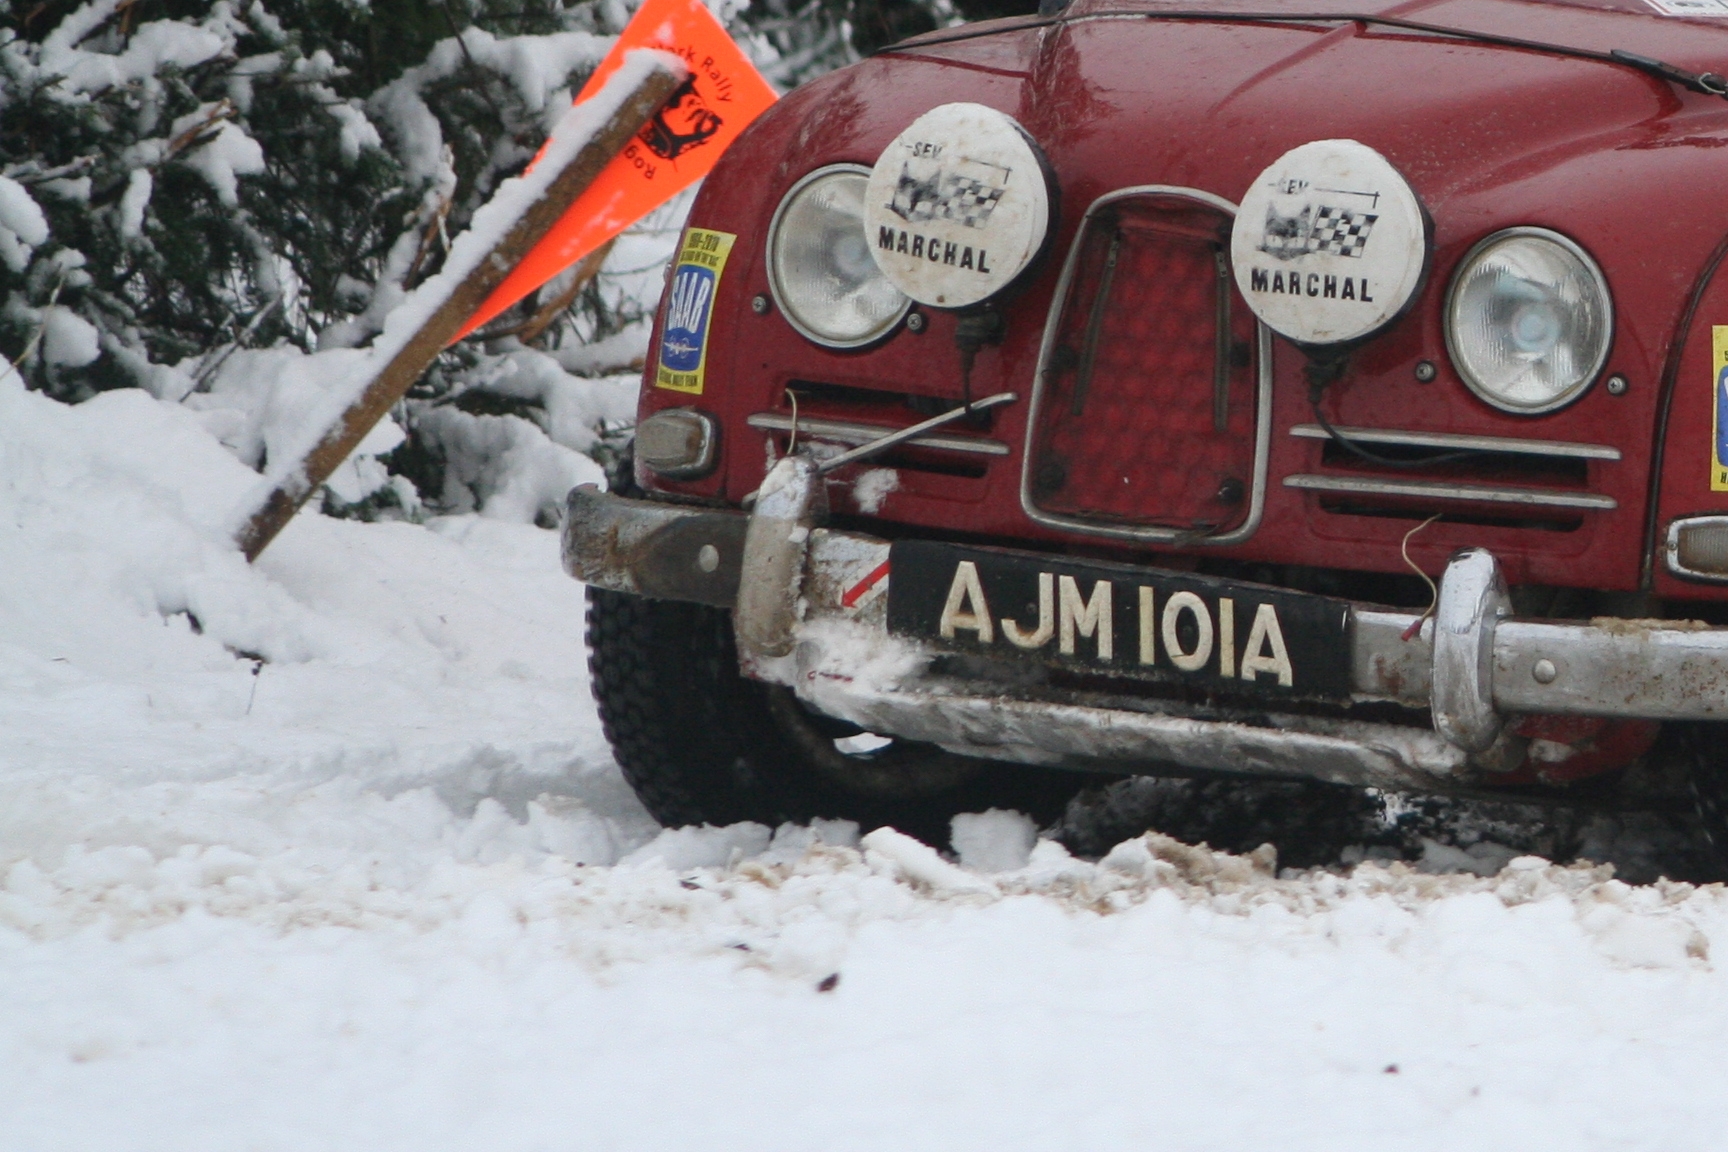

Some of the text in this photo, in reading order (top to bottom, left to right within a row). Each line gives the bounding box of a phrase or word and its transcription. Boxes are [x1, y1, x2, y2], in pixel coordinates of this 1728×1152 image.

[701, 56, 732, 102] Rally
[879, 225, 990, 274] MARCHAL
[668, 272, 711, 334] SAAB
[1251, 266, 1373, 302] MARCHAL
[939, 560, 1293, 687] AJM 101A
